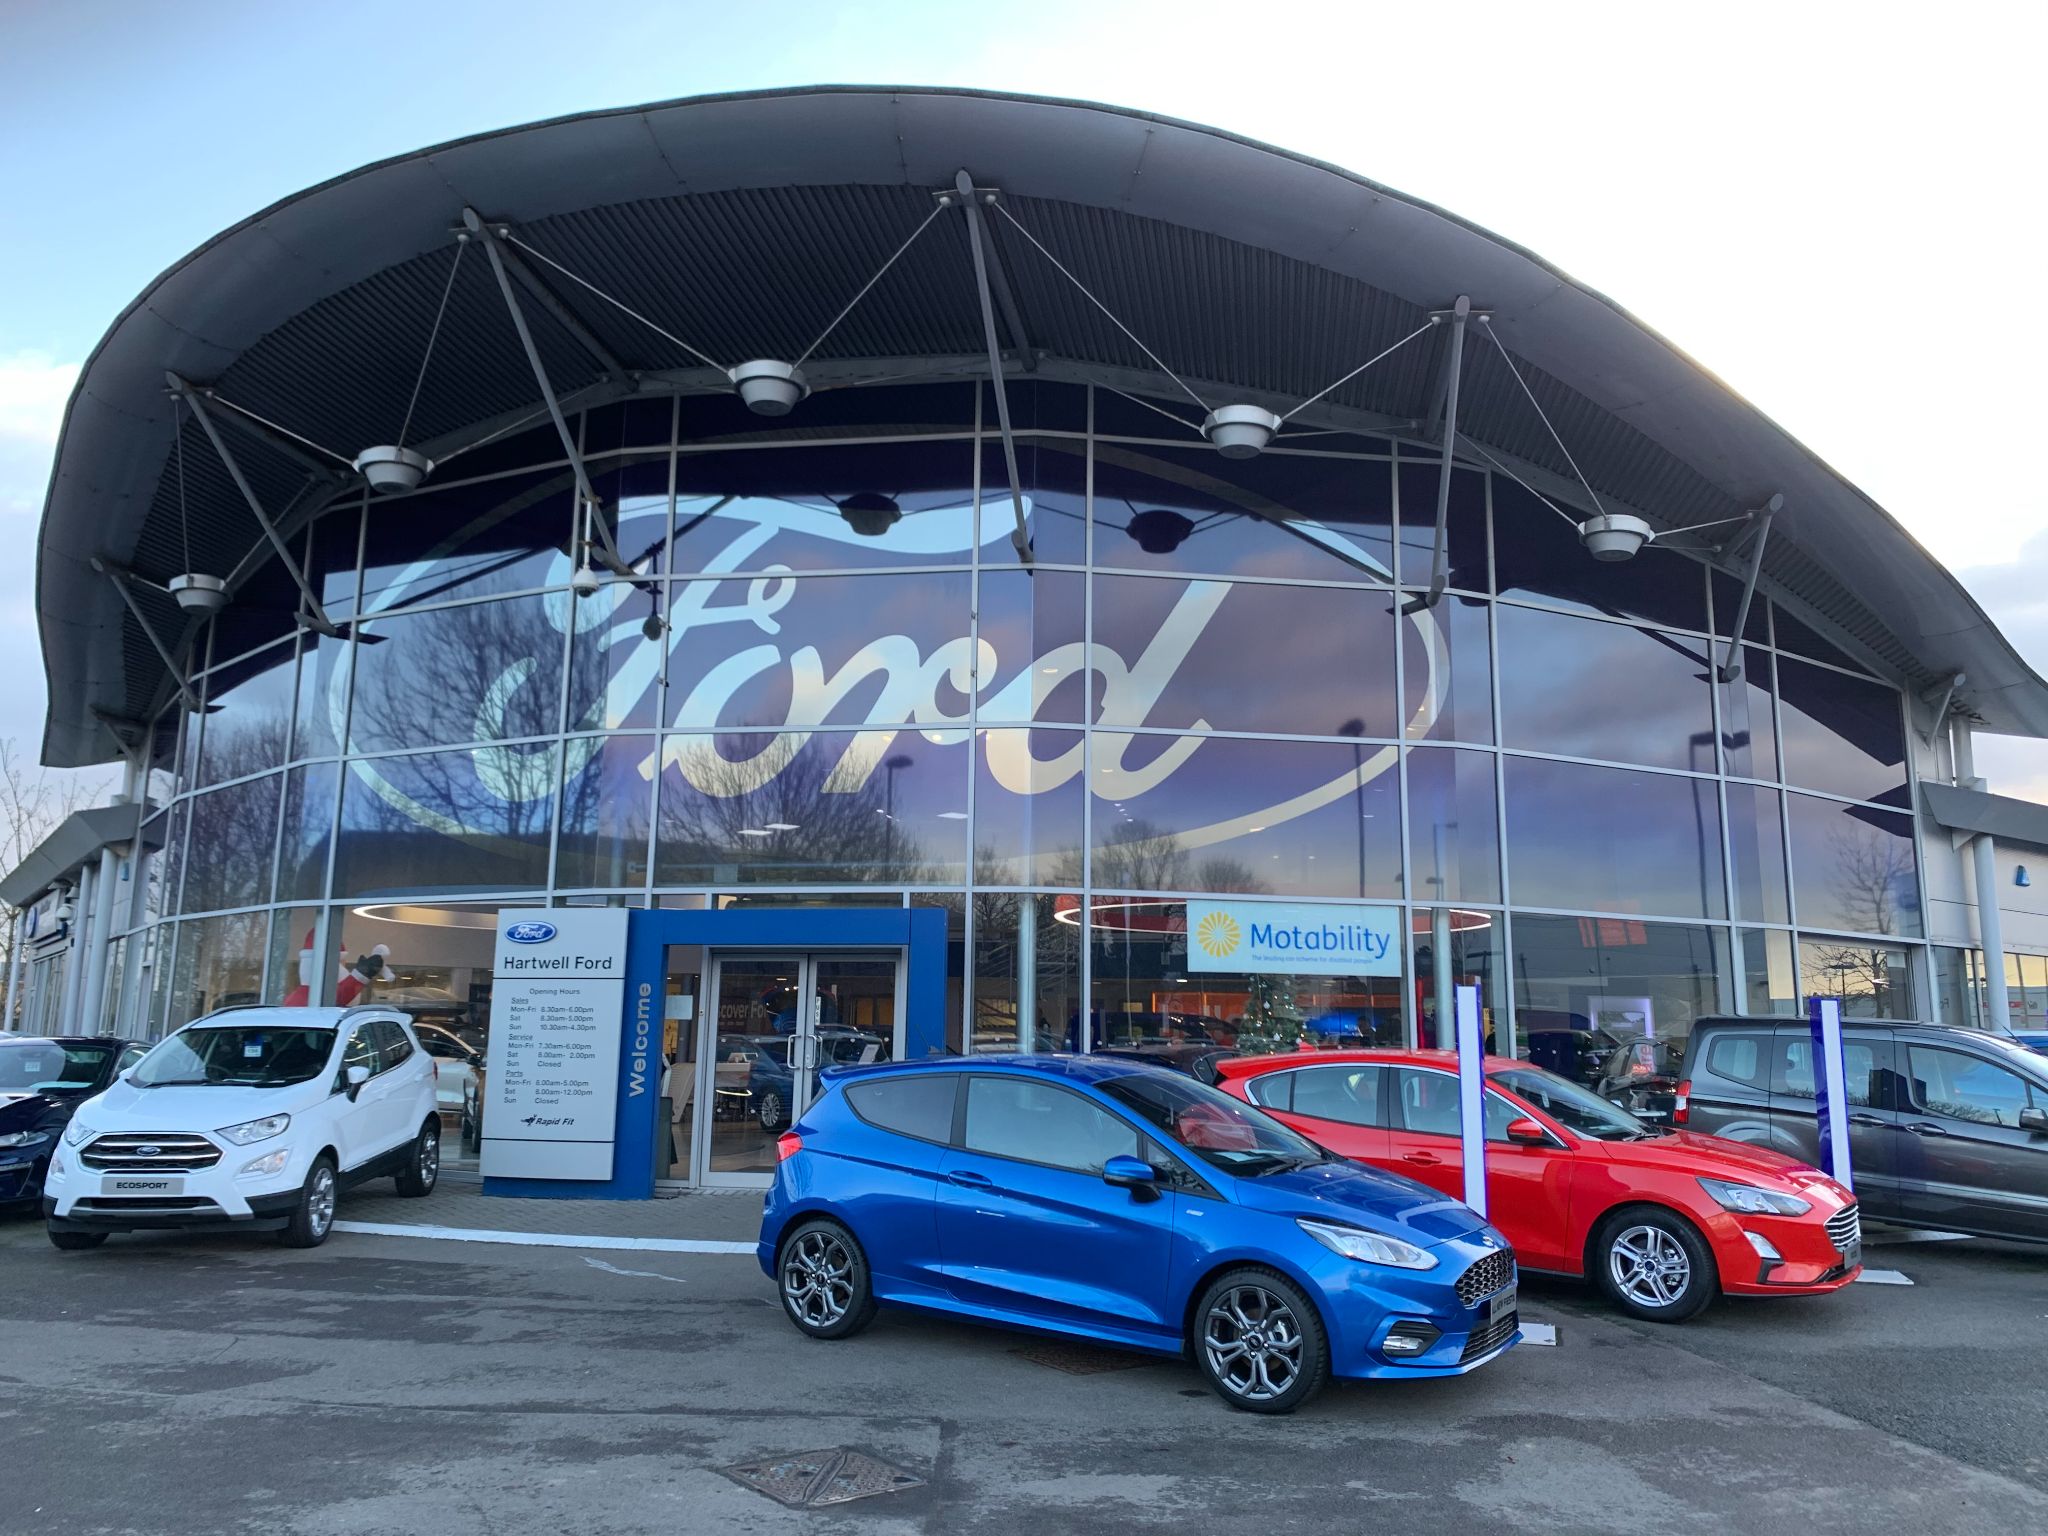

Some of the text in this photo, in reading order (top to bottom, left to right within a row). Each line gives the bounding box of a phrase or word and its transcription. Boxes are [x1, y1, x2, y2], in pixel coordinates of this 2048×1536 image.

[473, 494, 1230, 801] Ford
[1251, 923, 1390, 959] Motability
[504, 956, 612, 969] Hartwell Ford
[720, 1004, 749, 1019] cover
[538, 1042, 592, 1050] 7.30am-6.00pm
[628, 983, 651, 1097] Welcome
[535, 1117, 575, 1126] Rapid Fit
